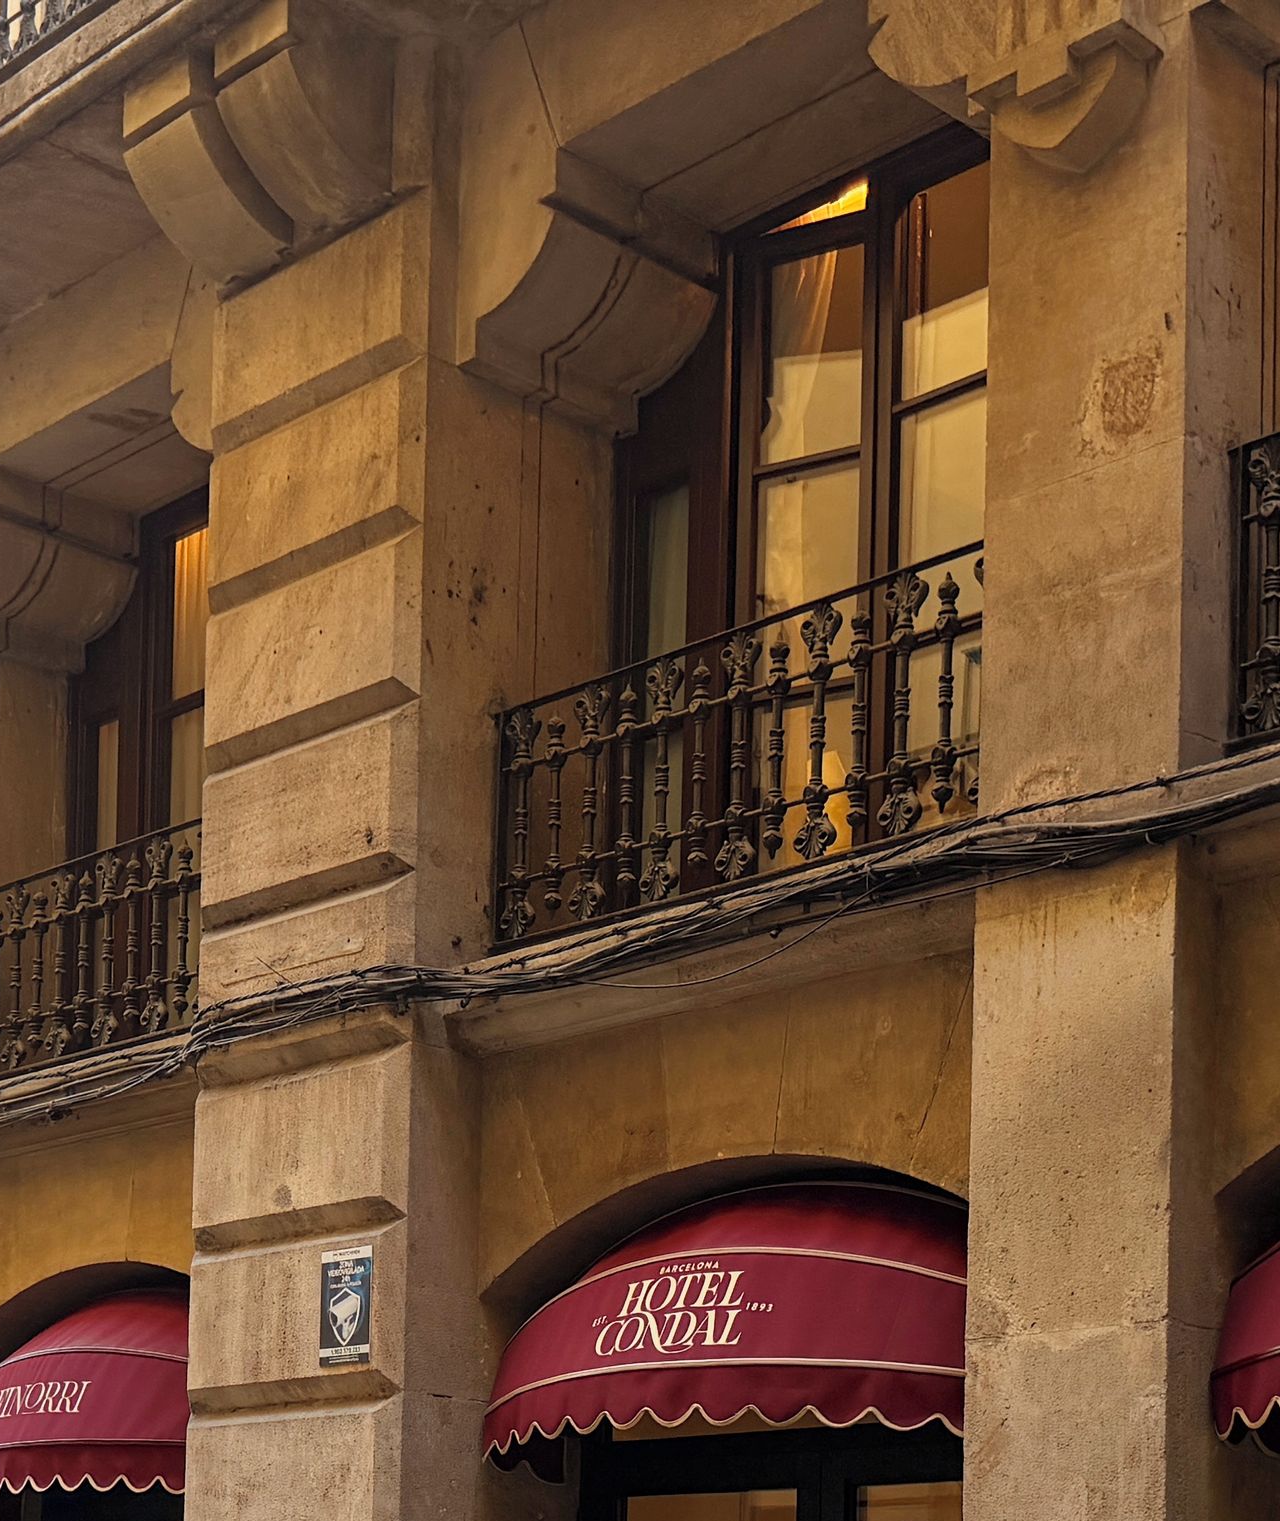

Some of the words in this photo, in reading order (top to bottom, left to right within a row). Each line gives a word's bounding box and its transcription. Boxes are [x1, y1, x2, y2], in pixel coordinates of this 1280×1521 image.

[659, 1260, 720, 1275] BARCELONA
[616, 1270, 745, 1318] HOTEL
[745, 1302, 774, 1313] 1893
[591, 1315, 608, 1328] EST.
[594, 1309, 742, 1356] CONDAL
